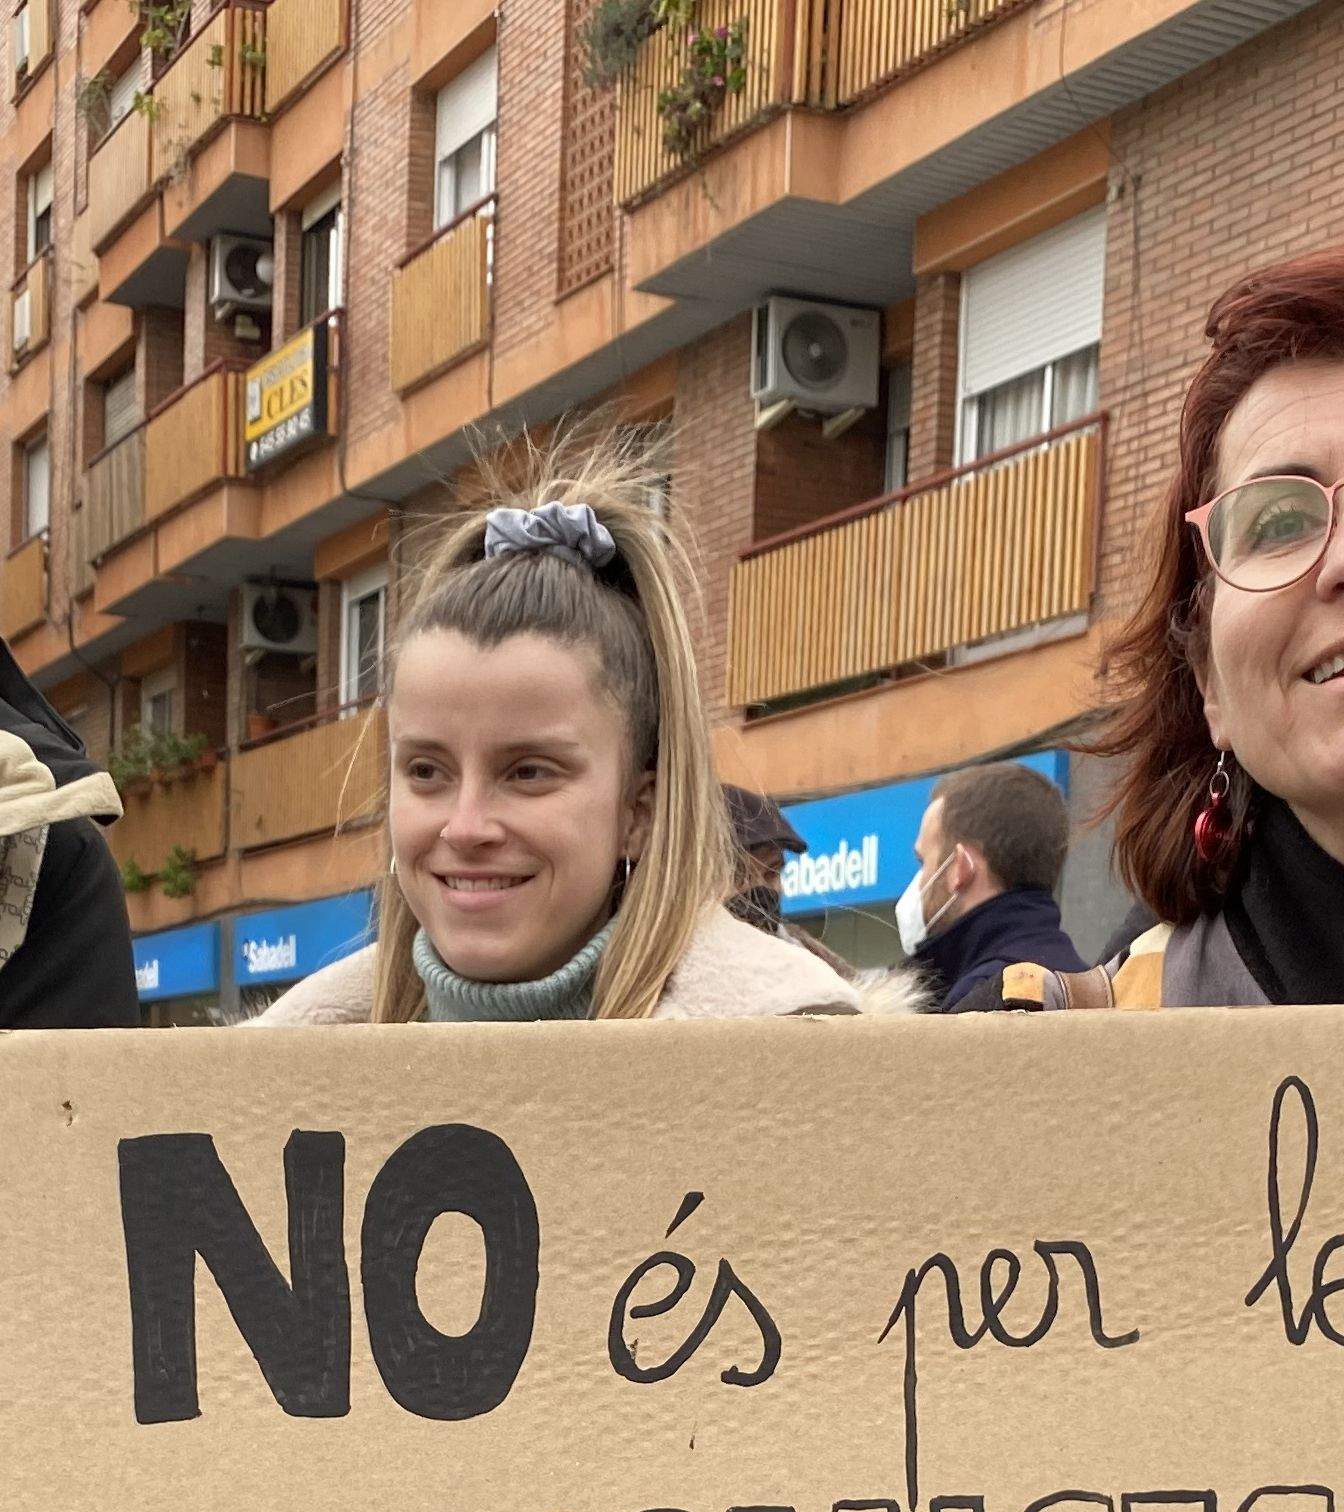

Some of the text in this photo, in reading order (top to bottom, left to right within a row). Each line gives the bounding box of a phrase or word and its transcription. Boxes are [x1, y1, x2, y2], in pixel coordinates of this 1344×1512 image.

[781, 834, 879, 897] abadell
[118, 1123, 540, 1424] NO
[607, 1191, 782, 1388] és
[877, 1239, 1141, 1510] per
